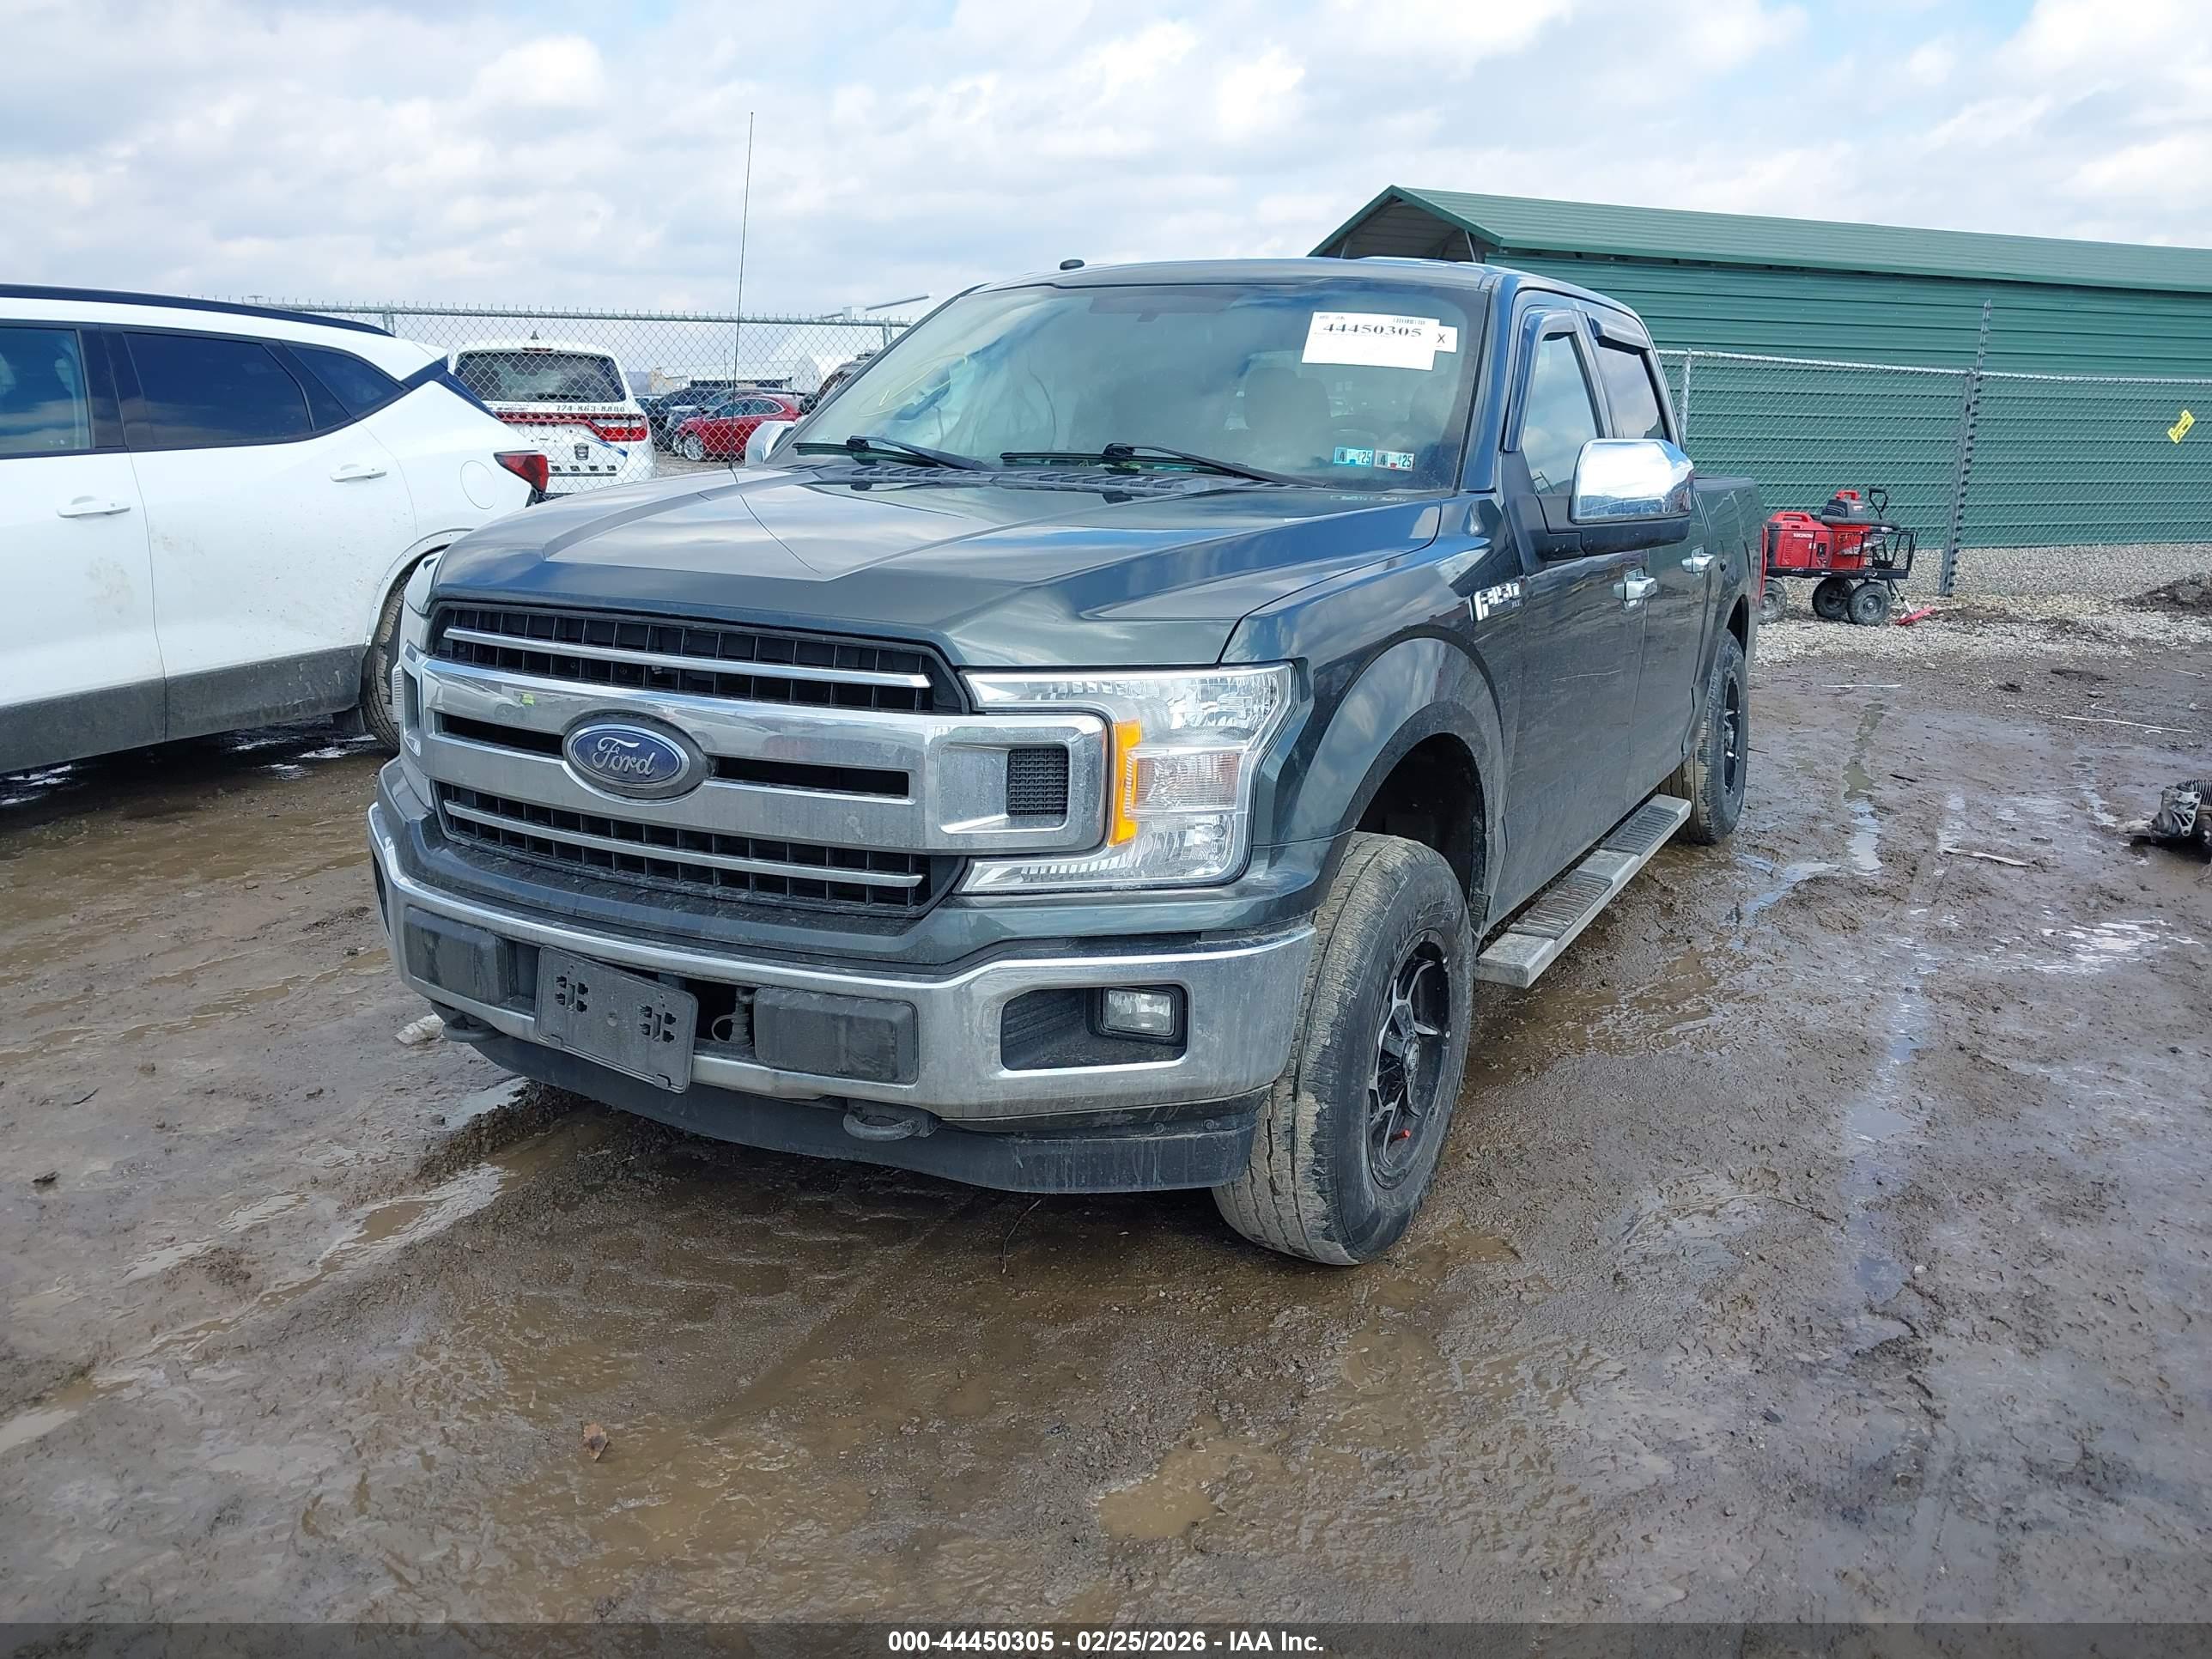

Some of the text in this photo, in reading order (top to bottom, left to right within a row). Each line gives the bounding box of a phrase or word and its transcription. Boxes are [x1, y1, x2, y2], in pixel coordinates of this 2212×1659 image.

[1322, 323, 1423, 337] 44450305
[1437, 333, 1446, 343] X
[1339, 451, 1372, 464] 4 25
[1380, 454, 1413, 467] 4 25
[592, 737, 656, 775] Ford
